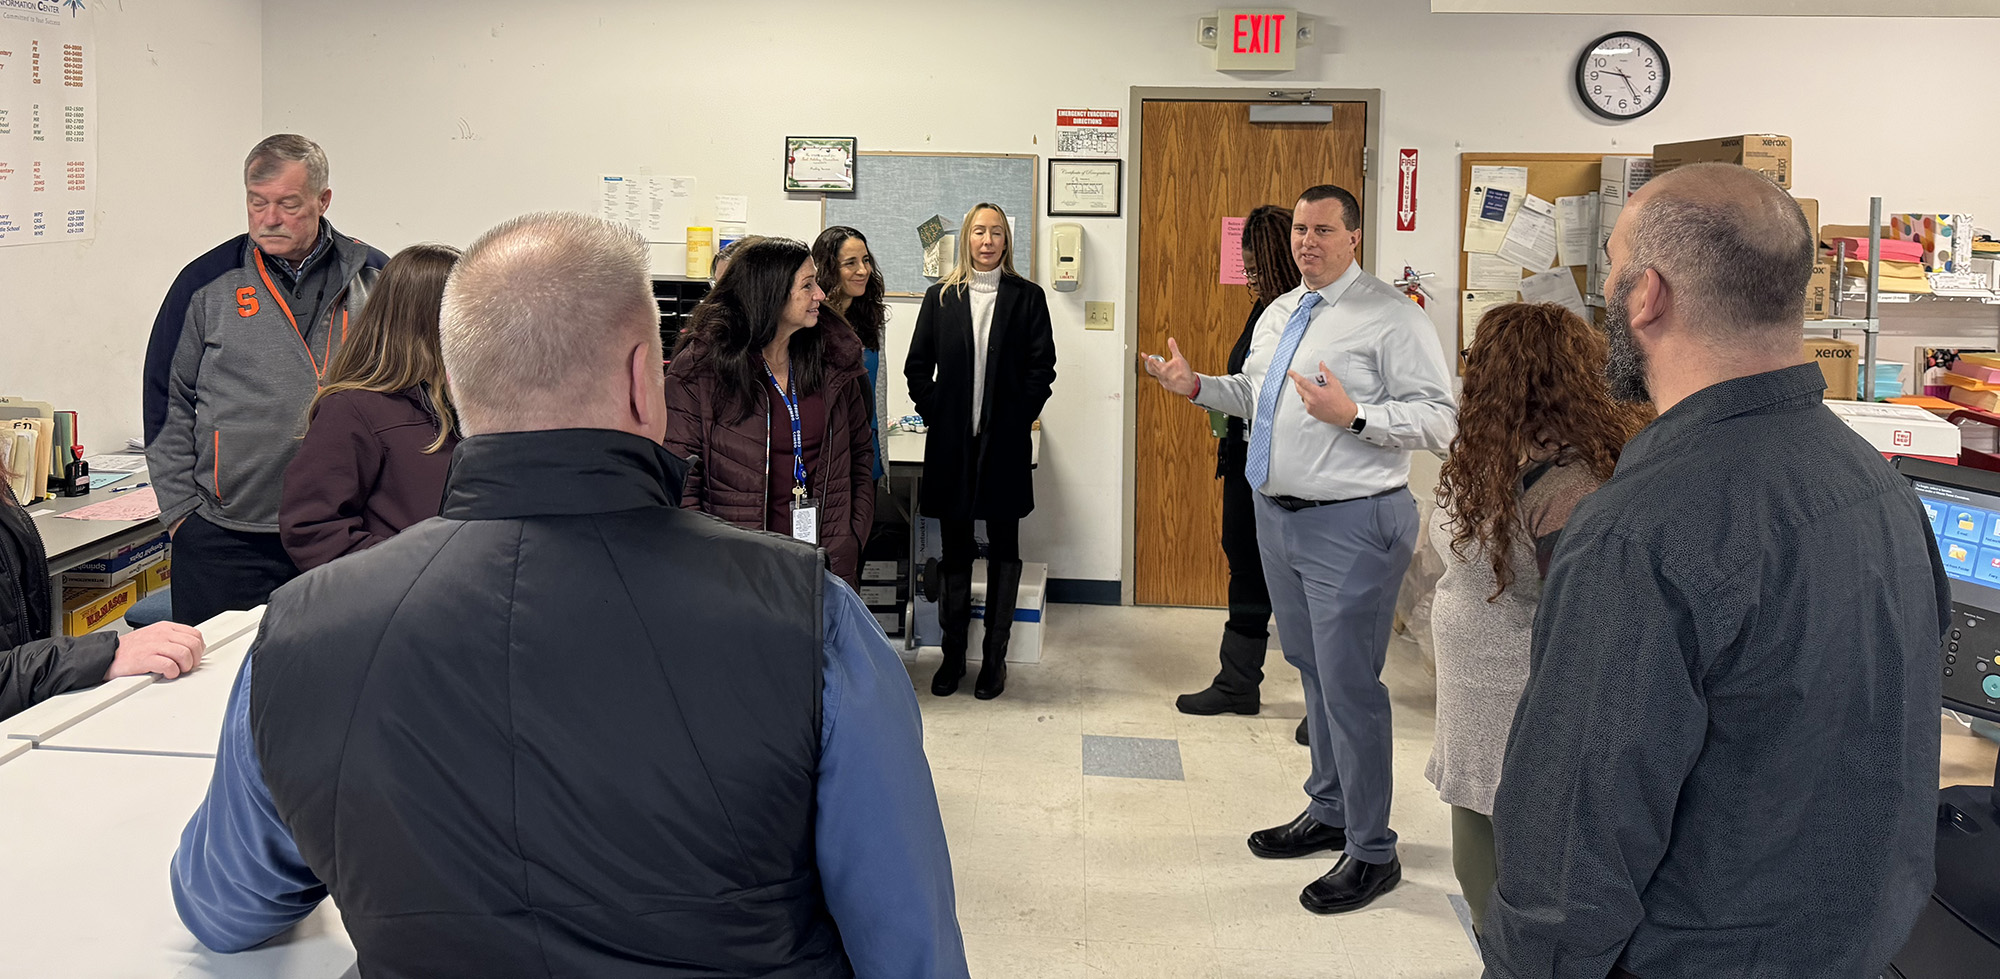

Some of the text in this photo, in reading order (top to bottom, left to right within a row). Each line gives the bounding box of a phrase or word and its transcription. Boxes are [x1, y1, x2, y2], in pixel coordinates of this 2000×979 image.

[0, 0, 60, 14] NFORMATION CENTER
[3, 12, 30, 22] Committed
[1233, 14, 1286, 54] EXIT
[1594, 58, 1606, 67] 10
[1645, 58, 1652, 67] 2
[1590, 71, 1598, 80] 9
[1648, 71, 1656, 80] 3
[1594, 85, 1602, 94] 8
[1644, 85, 1651, 94] 4
[1604, 95, 1612, 105] 7
[1618, 99, 1627, 108] 6
[1633, 95, 1641, 105] 5
[1762, 139, 1786, 147] xerox
[236, 286, 260, 318] S
[1815, 348, 1852, 358] xerox
